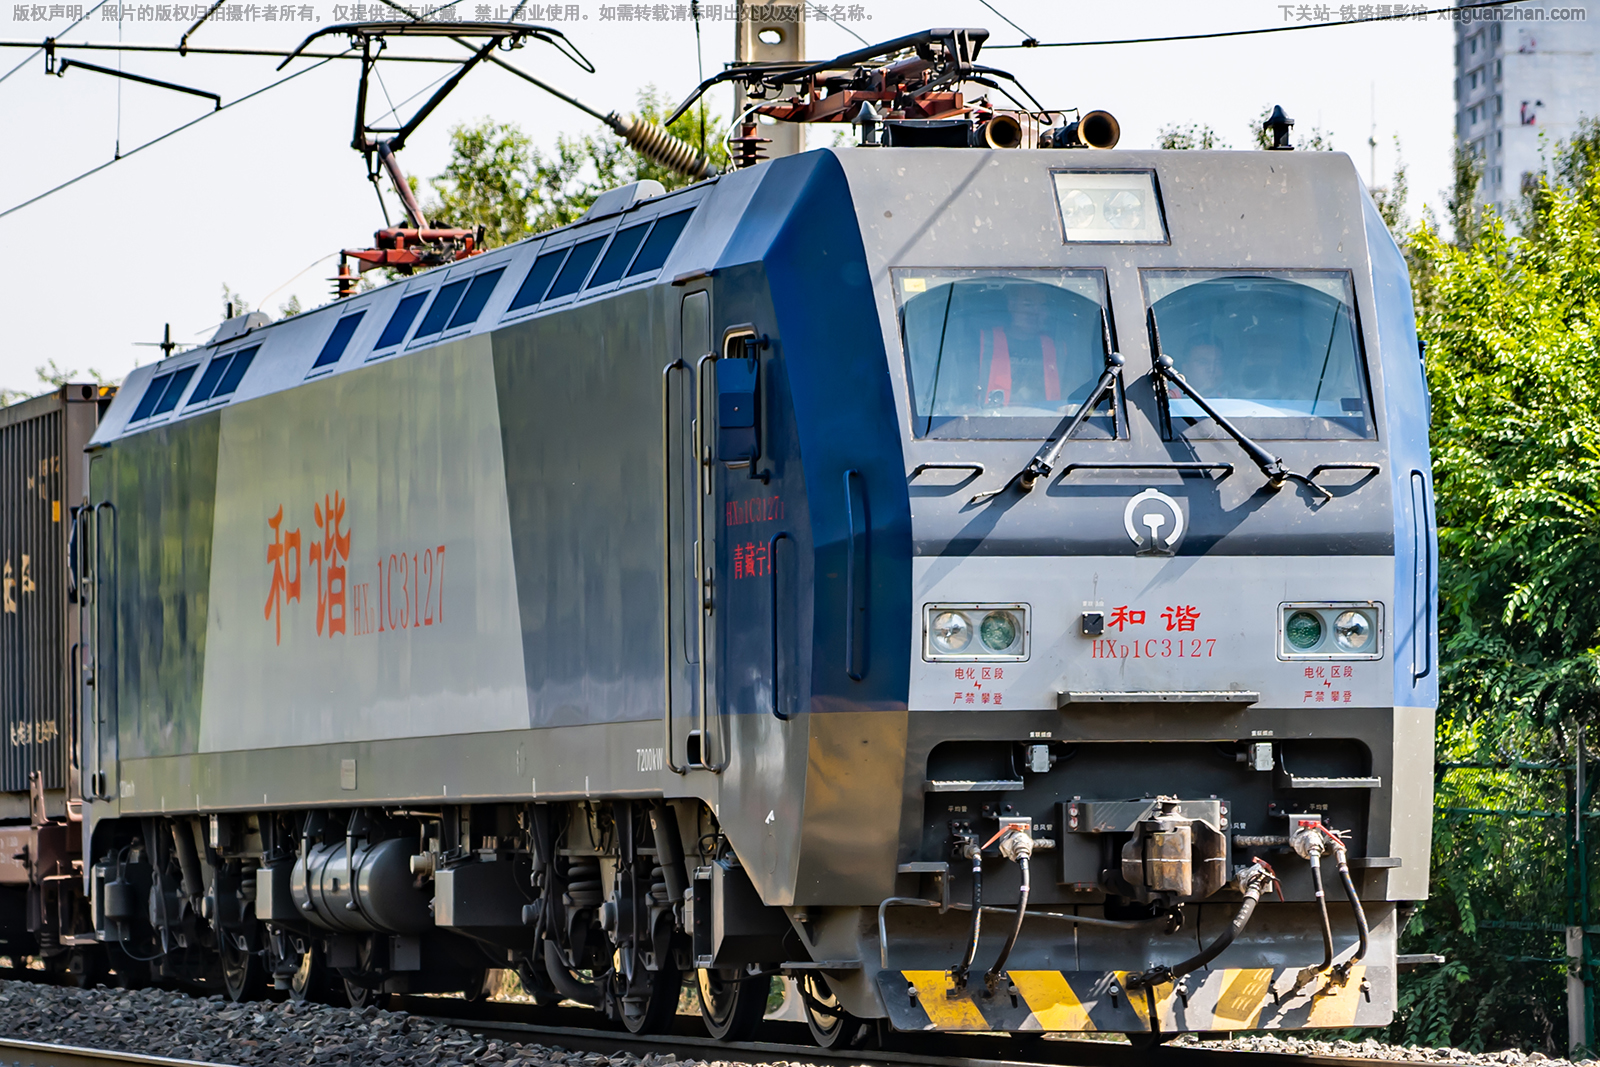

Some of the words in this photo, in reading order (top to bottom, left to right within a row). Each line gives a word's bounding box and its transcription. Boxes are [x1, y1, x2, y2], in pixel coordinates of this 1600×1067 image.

[264, 489, 351, 647] 和谐
[353, 545, 446, 636] HXD1C3127
[1107, 605, 1201, 632] 和谐
[1092, 638, 1217, 658] HXD1C3127
[636, 748, 663, 771] 7200kW
